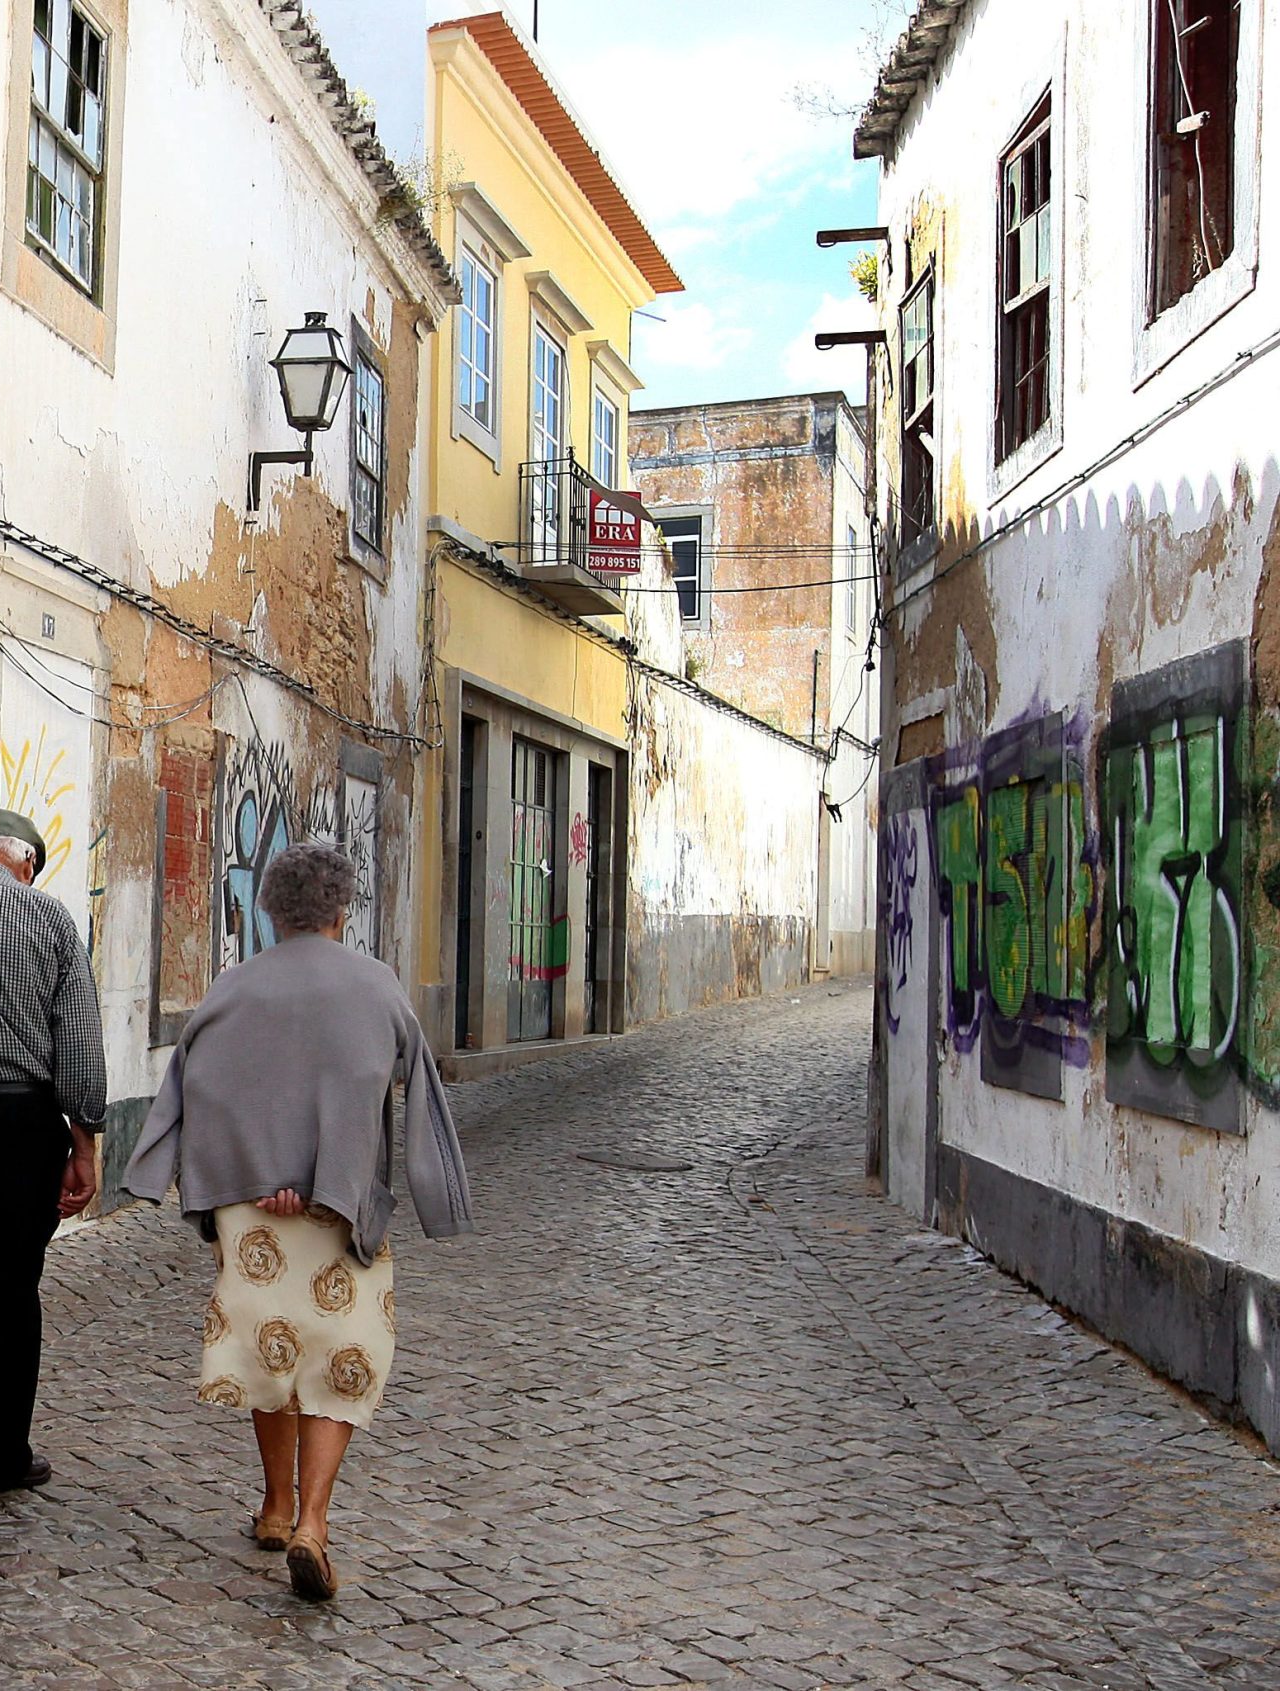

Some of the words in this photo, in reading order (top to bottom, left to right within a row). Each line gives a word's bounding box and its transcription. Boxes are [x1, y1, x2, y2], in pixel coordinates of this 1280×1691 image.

[595, 525, 635, 541] ERA
[589, 556, 606, 567] 289
[607, 556, 625, 568] 895
[626, 558, 640, 568] 151
